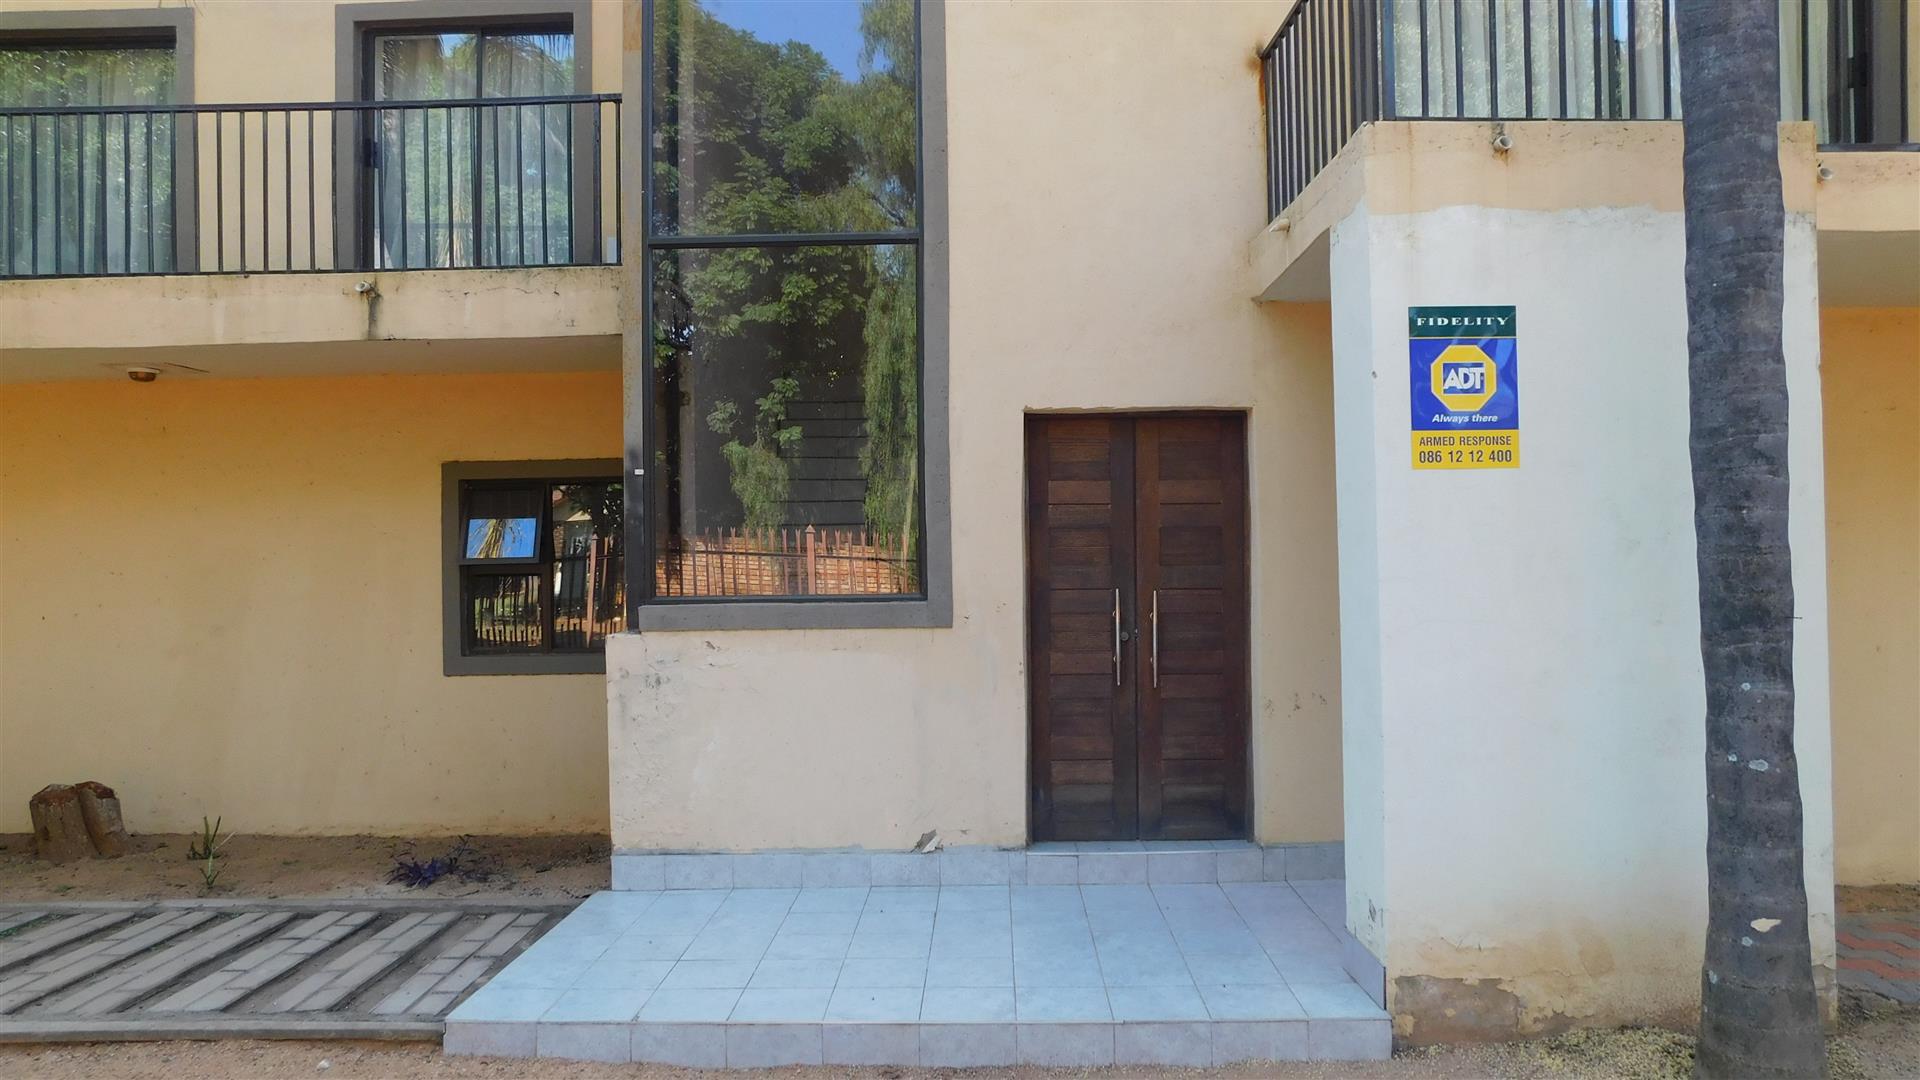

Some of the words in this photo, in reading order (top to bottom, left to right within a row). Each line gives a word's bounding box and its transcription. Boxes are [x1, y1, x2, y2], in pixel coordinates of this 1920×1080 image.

[1416, 317, 1509, 326] FIDELITY
[1443, 367, 1485, 389] ADT
[1432, 414, 1469, 424] Always
[1472, 414, 1498, 422] there
[1419, 436, 1455, 446] ARMED
[1459, 435, 1512, 446] RESPONSE
[1419, 450, 1442, 464] 086
[1448, 450, 1463, 463] 12
[1468, 450, 1484, 463] 12
[1489, 449, 1512, 462] 400
